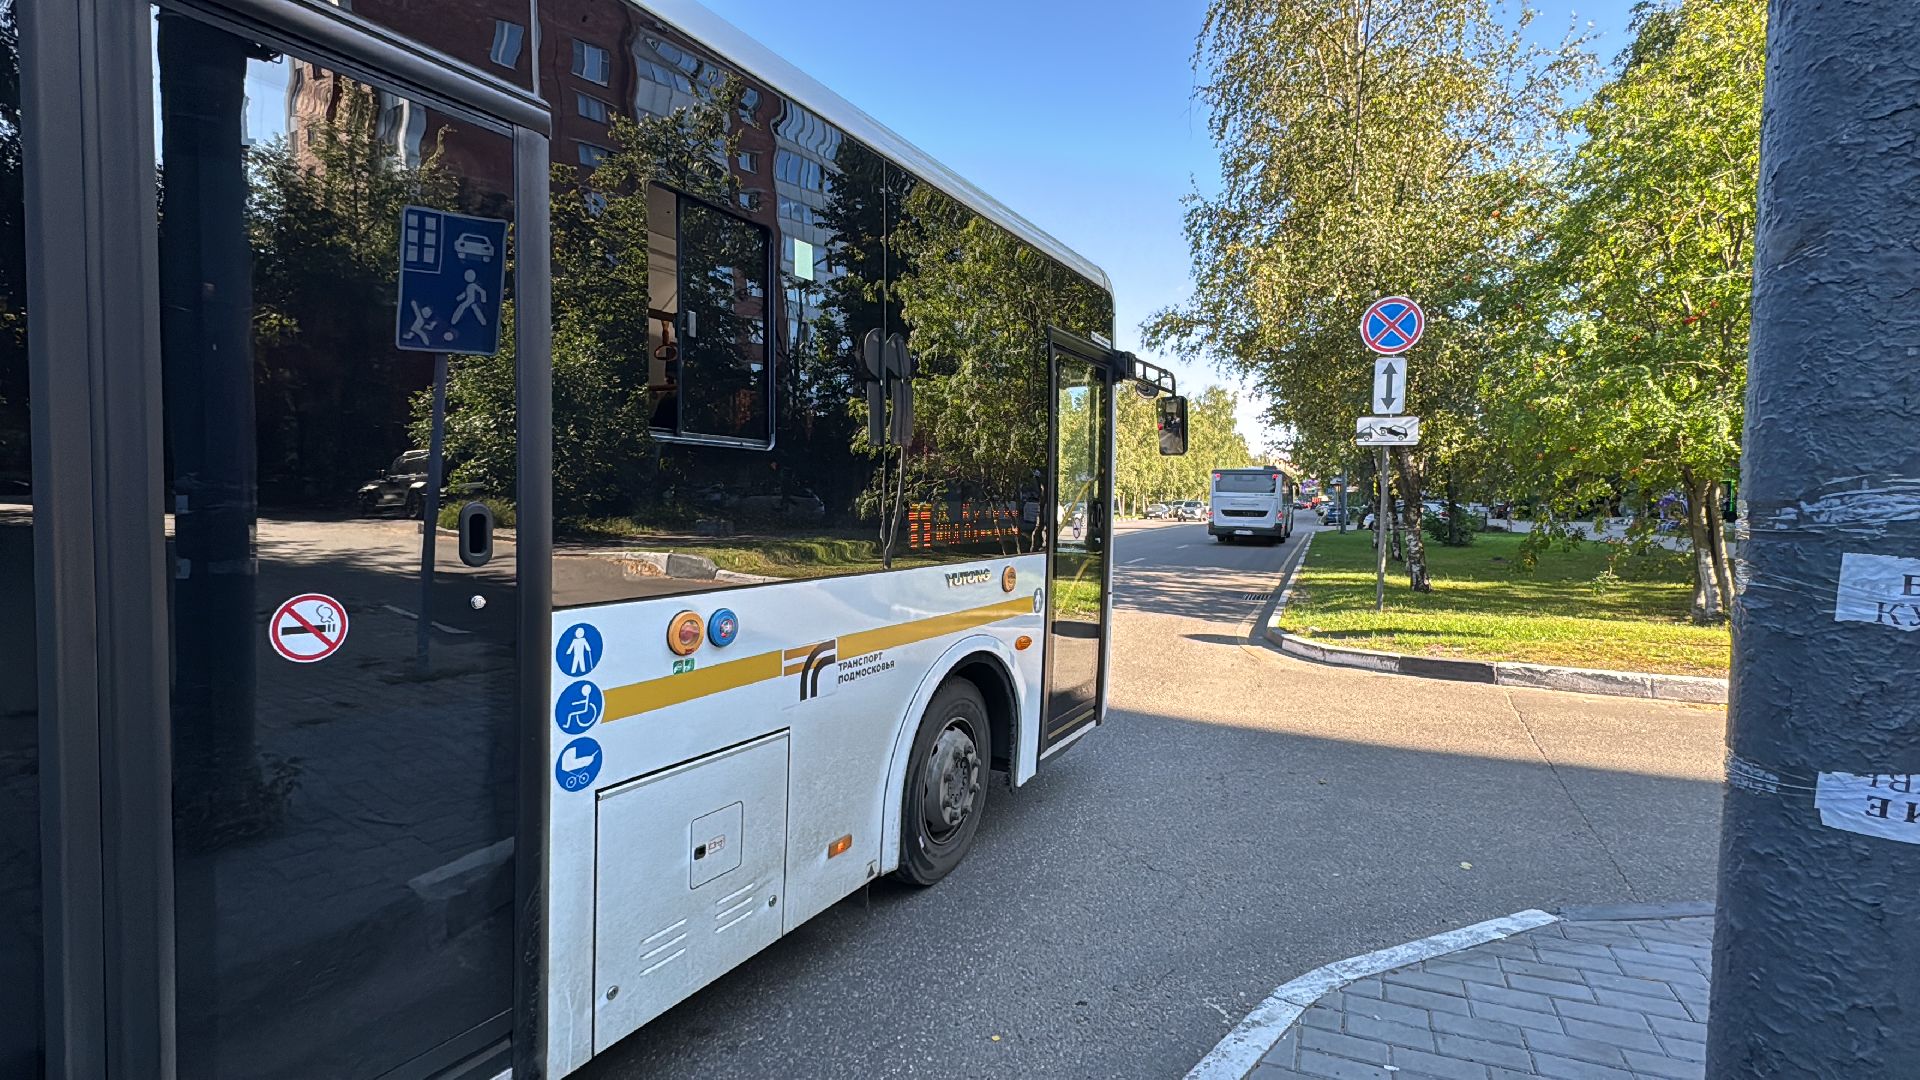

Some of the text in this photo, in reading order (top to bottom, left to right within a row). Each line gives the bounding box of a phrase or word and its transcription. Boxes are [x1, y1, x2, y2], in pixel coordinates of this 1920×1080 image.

[945, 568, 992, 588] YUTONG
[837, 651, 883, 672] ТРАНСПОРТ
[837, 660, 895, 685] ПОДМОСКОВЬЯ
